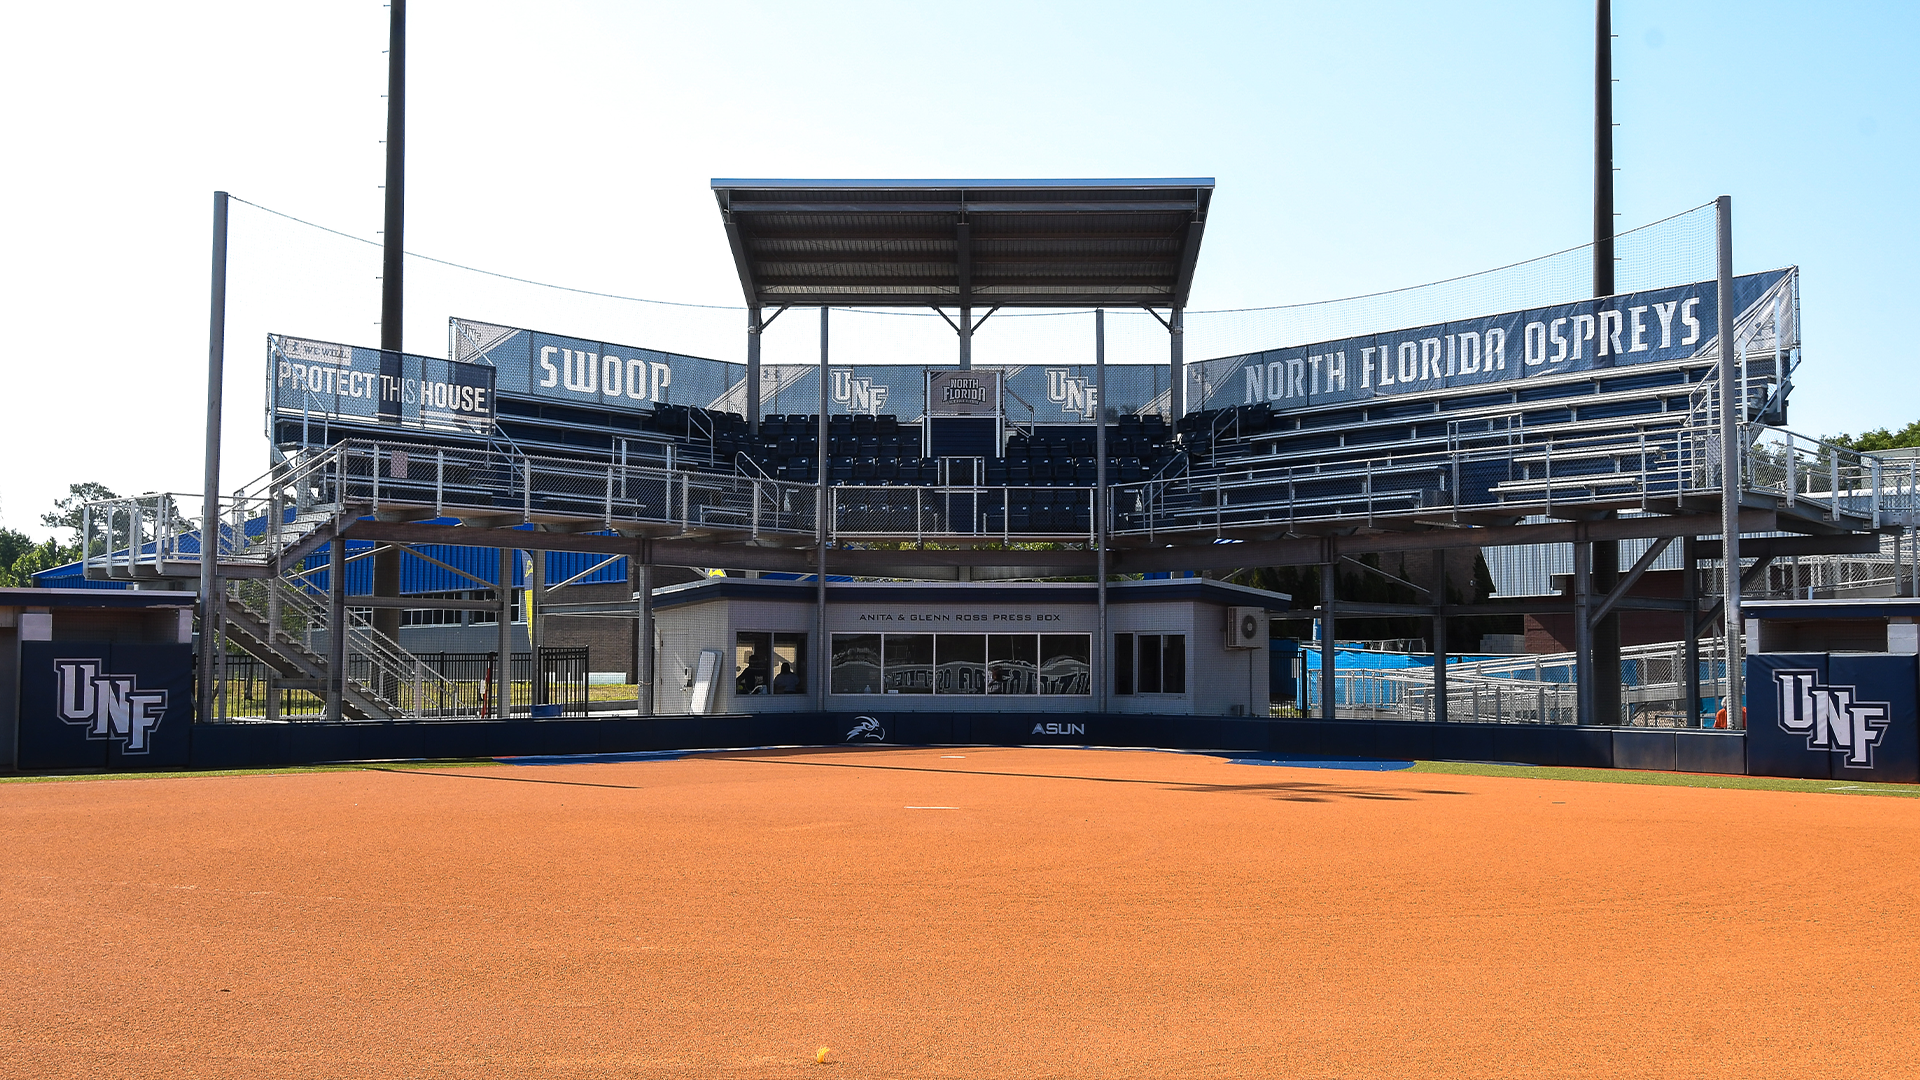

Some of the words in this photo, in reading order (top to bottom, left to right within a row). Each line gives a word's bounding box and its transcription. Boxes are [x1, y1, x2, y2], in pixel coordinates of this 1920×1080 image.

[540, 345, 671, 402] SWOOP
[1244, 351, 1346, 404] NORTH
[1360, 326, 1506, 388] FLORIDA
[1524, 297, 1701, 366] OSPREYS
[278, 361, 376, 399] PROTECT
[379, 374, 417, 405] THIS
[830, 368, 889, 415] UNF
[942, 386, 986, 402] FLORIDA
[949, 378, 980, 389] NORTH
[54, 658, 168, 755] UNF
[1031, 722, 1085, 735] ASUN
[1772, 668, 1890, 769] UNF
